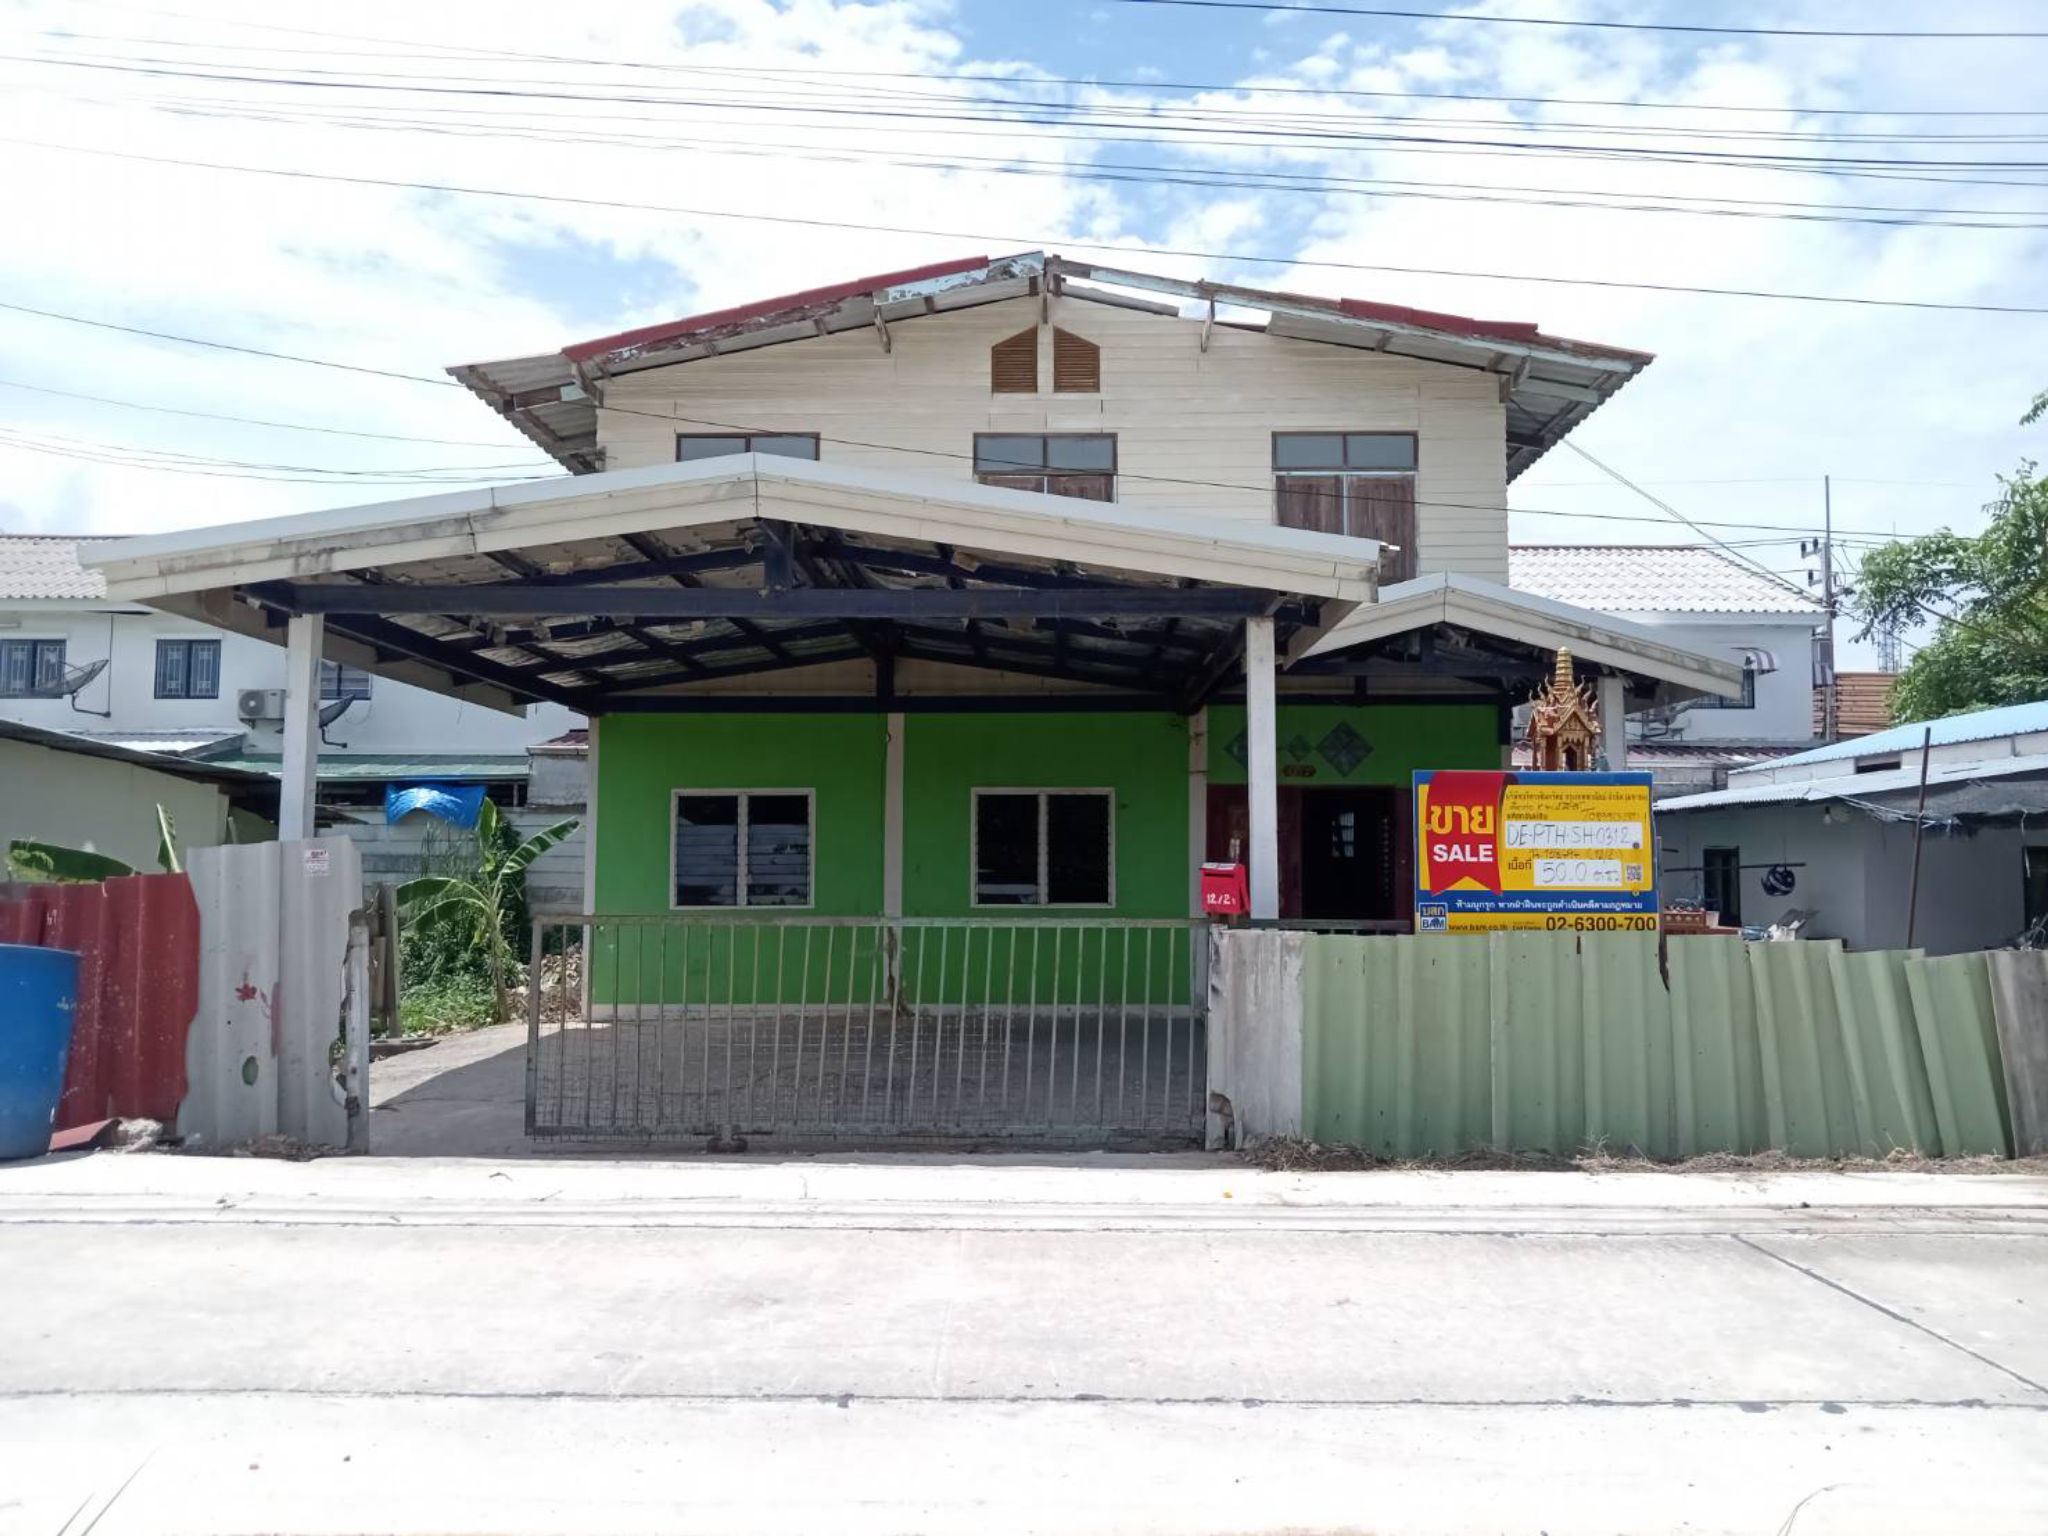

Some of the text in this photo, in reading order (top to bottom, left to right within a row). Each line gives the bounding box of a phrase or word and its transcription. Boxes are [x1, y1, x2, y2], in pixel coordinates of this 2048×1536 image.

[1430, 805, 1494, 834] ขาย
[1433, 844, 1494, 862] SALE
[1508, 856, 1532, 870] เนื้อที่
[1422, 917, 1445, 929] BAM
[1546, 916, 1657, 931] 02-6300-700
